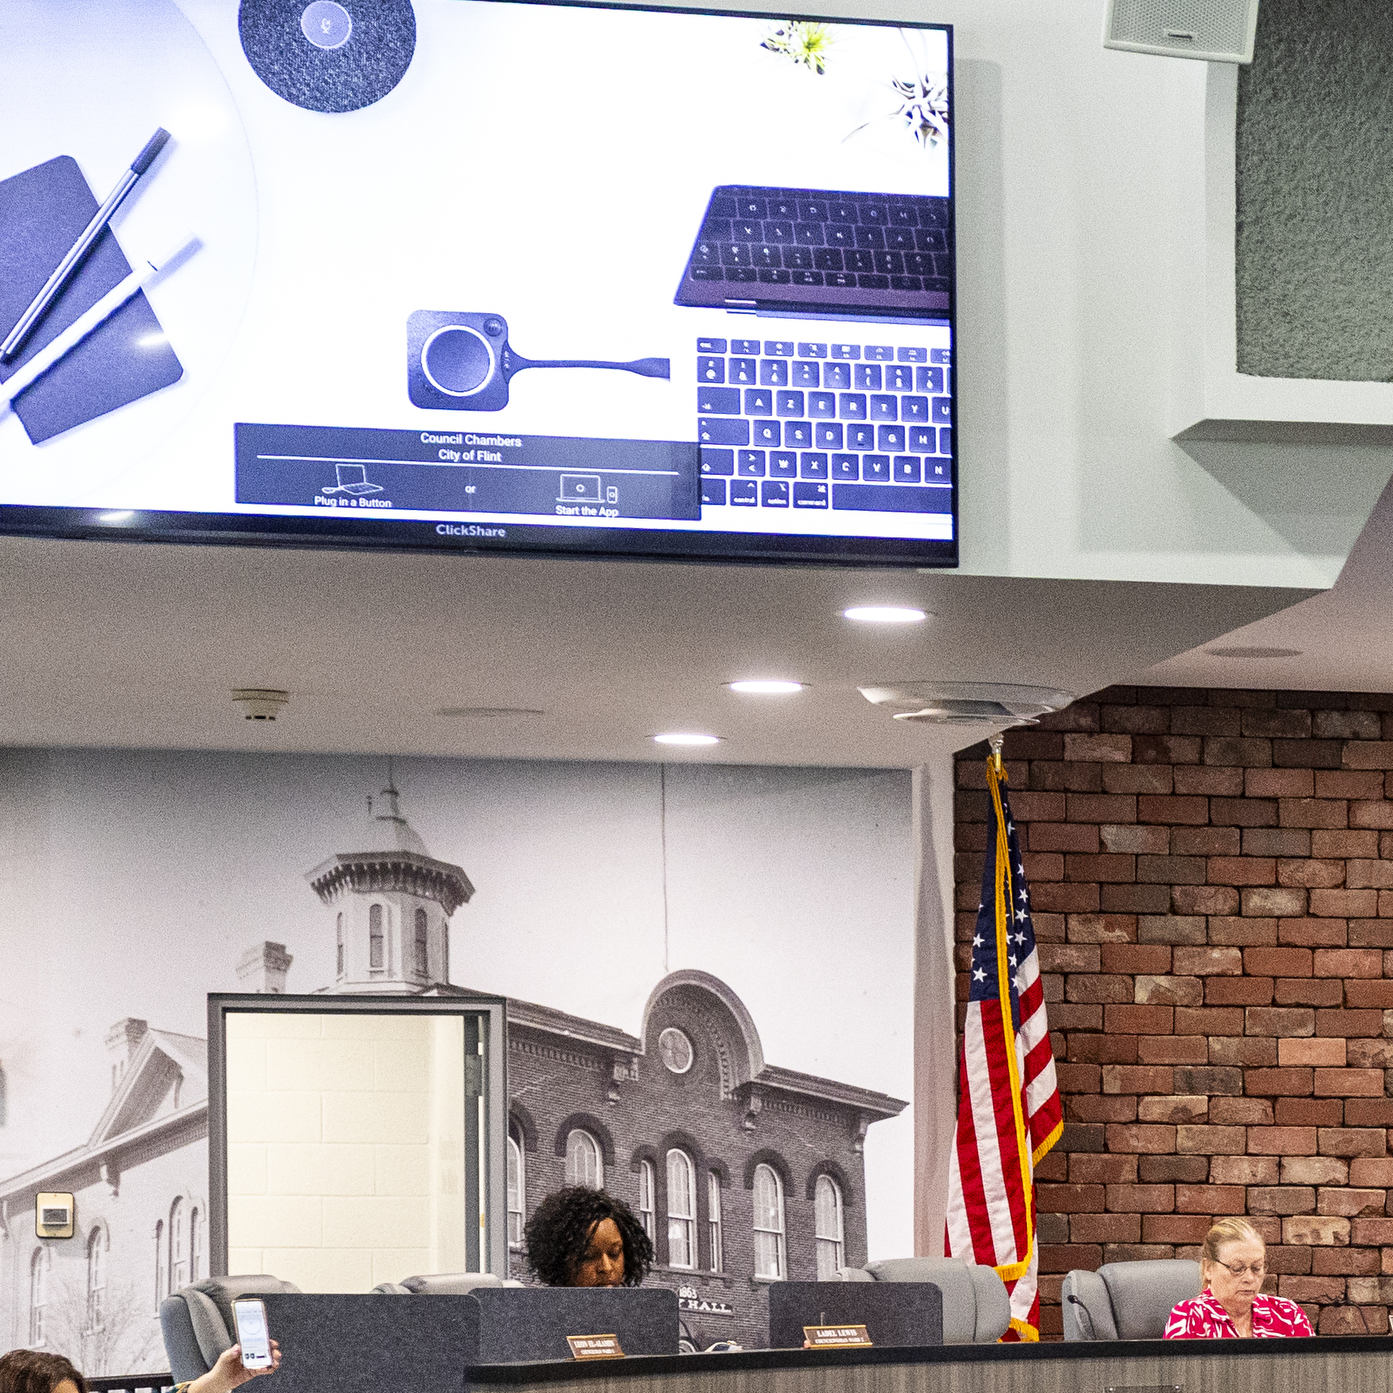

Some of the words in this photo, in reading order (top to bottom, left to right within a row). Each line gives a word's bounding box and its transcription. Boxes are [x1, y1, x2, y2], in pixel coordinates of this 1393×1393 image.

[420, 432, 463, 445] Council
[464, 434, 523, 447] Chambers
[438, 448, 461, 463] City
[462, 449, 475, 461] of
[477, 450, 502, 463] Flint
[464, 485, 476, 494] or
[314, 496, 337, 508] Plug
[339, 496, 348, 507] in
[350, 499, 357, 507] a
[359, 497, 392, 508] Button
[555, 505, 580, 515] Start
[581, 505, 598, 516] the
[598, 507, 619, 518] App
[435, 524, 506, 537] ClickShare
[687, 1300, 732, 1313] HALL
